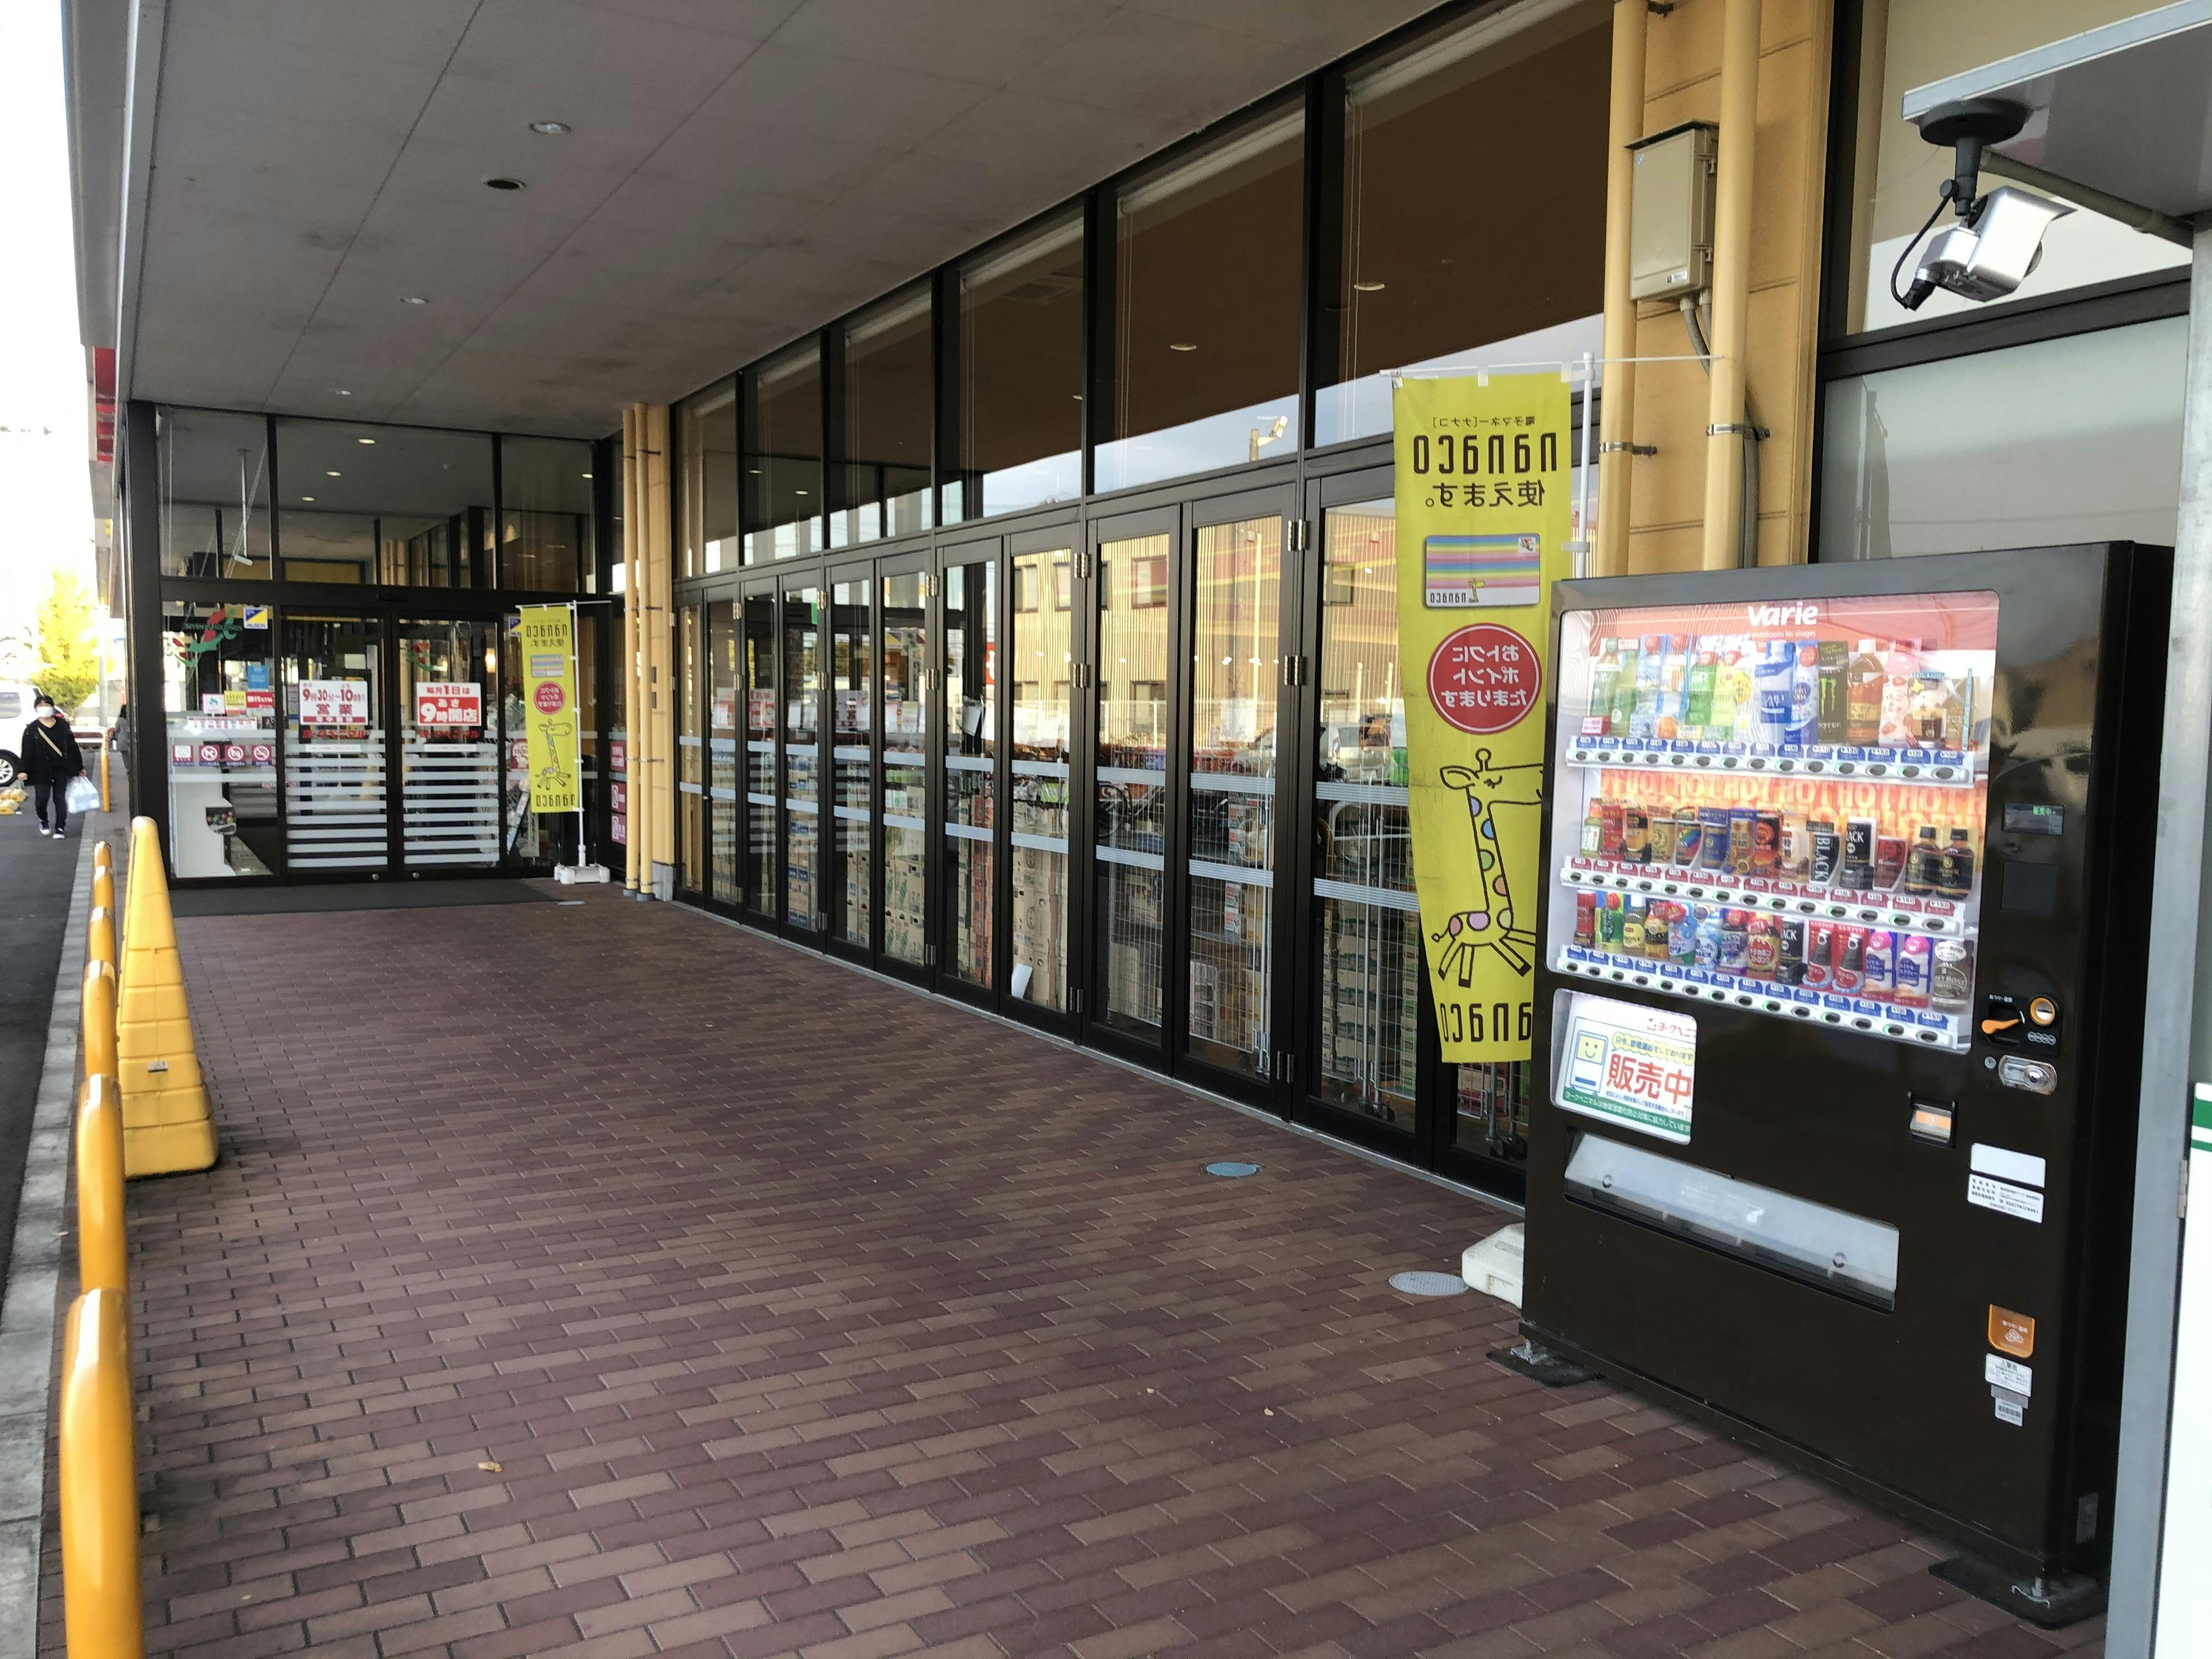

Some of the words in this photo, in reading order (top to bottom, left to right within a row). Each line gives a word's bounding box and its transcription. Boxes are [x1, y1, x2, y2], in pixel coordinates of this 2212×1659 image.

[1747, 601, 1819, 627] Varie
[421, 703, 478, 723] 9時開店
[438, 698, 460, 708] あさ
[1779, 778, 1832, 805] HOT
[1838, 781, 1895, 809] HOT
[1900, 784, 1960, 814] HOT
[1846, 831, 1864, 843] ACK
[1814, 837, 1831, 882] BLACK
[1781, 928, 1798, 941] ACK
[1606, 1053, 1692, 1105] 販売中
